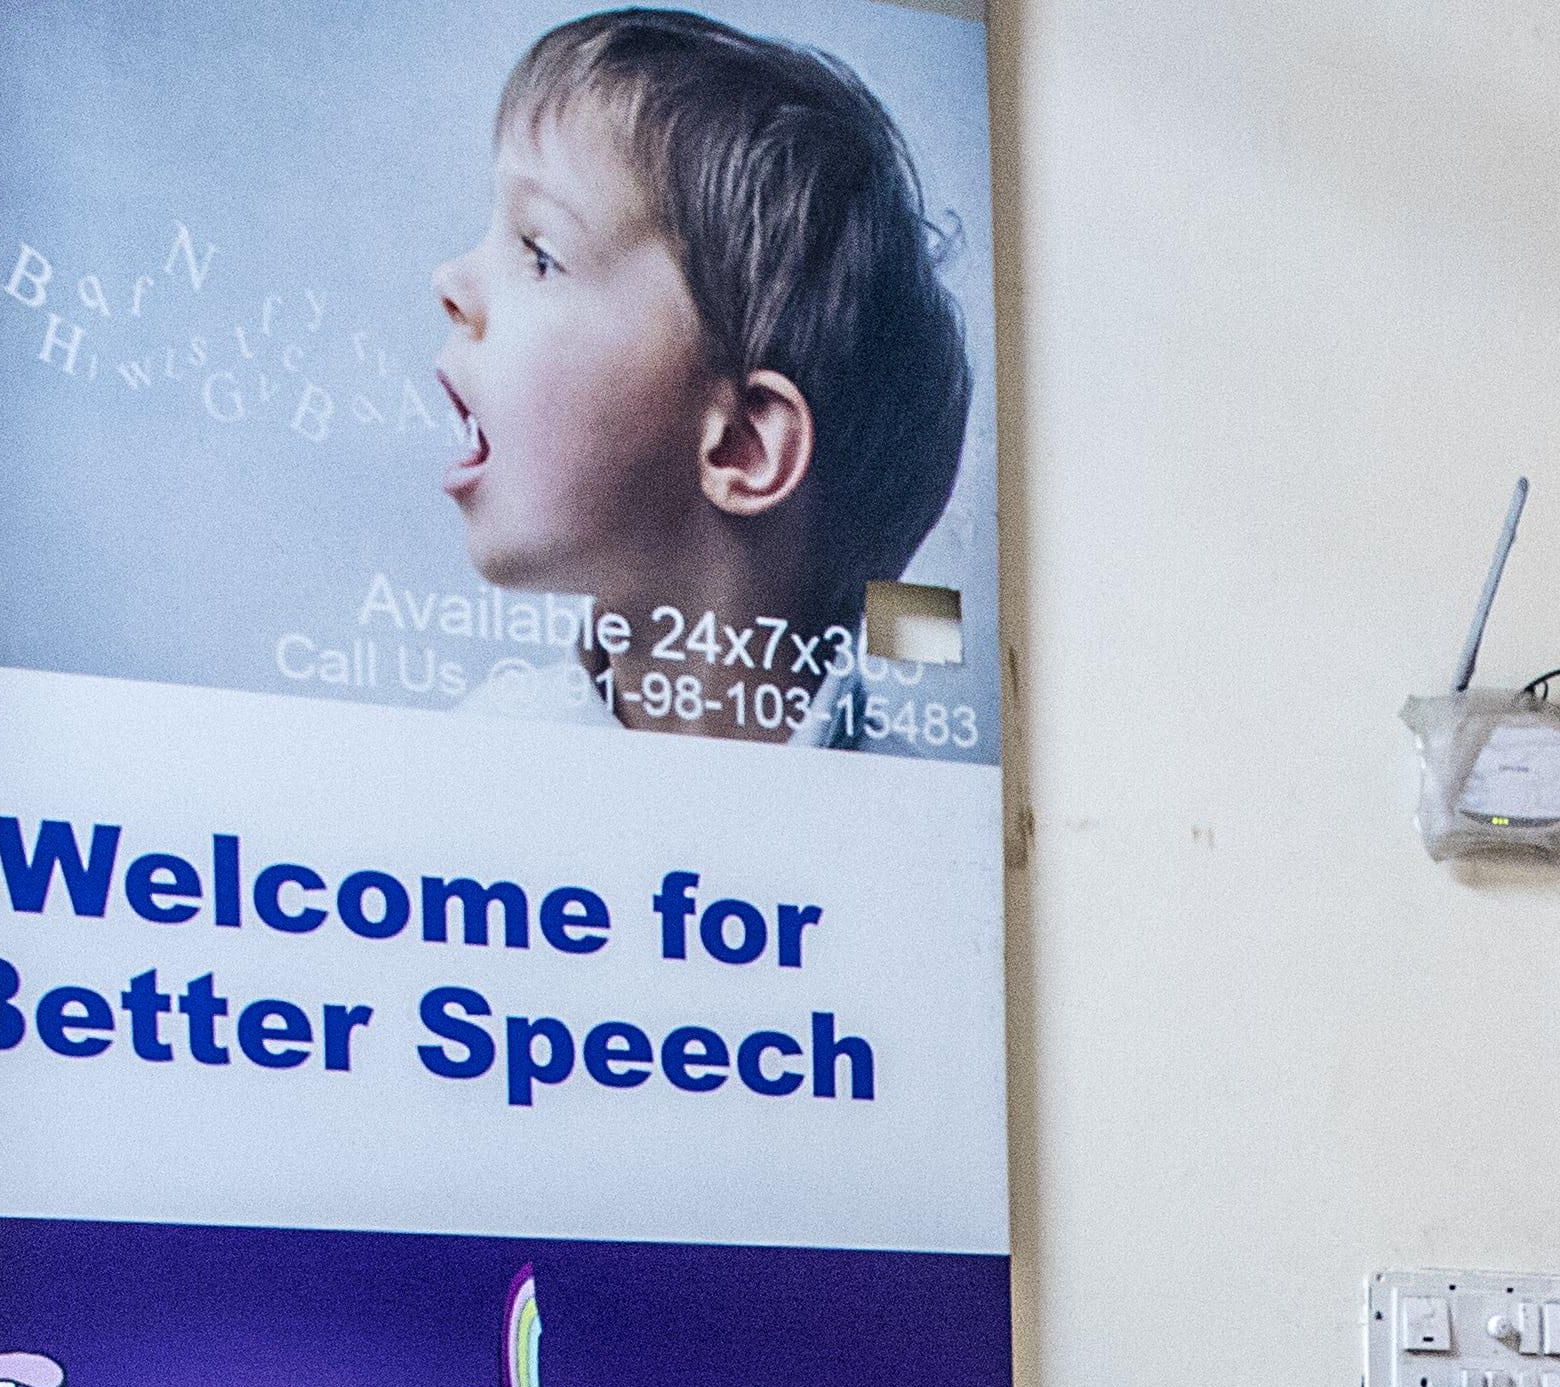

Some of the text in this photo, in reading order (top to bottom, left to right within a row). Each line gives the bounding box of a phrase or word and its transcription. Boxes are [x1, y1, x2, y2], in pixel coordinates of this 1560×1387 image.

[357, 572, 632, 655] Available
[276, 633, 375, 687] Call
[398, 646, 467, 696] Us
[653, 870, 821, 968] for
[416, 986, 877, 1107] Speech
